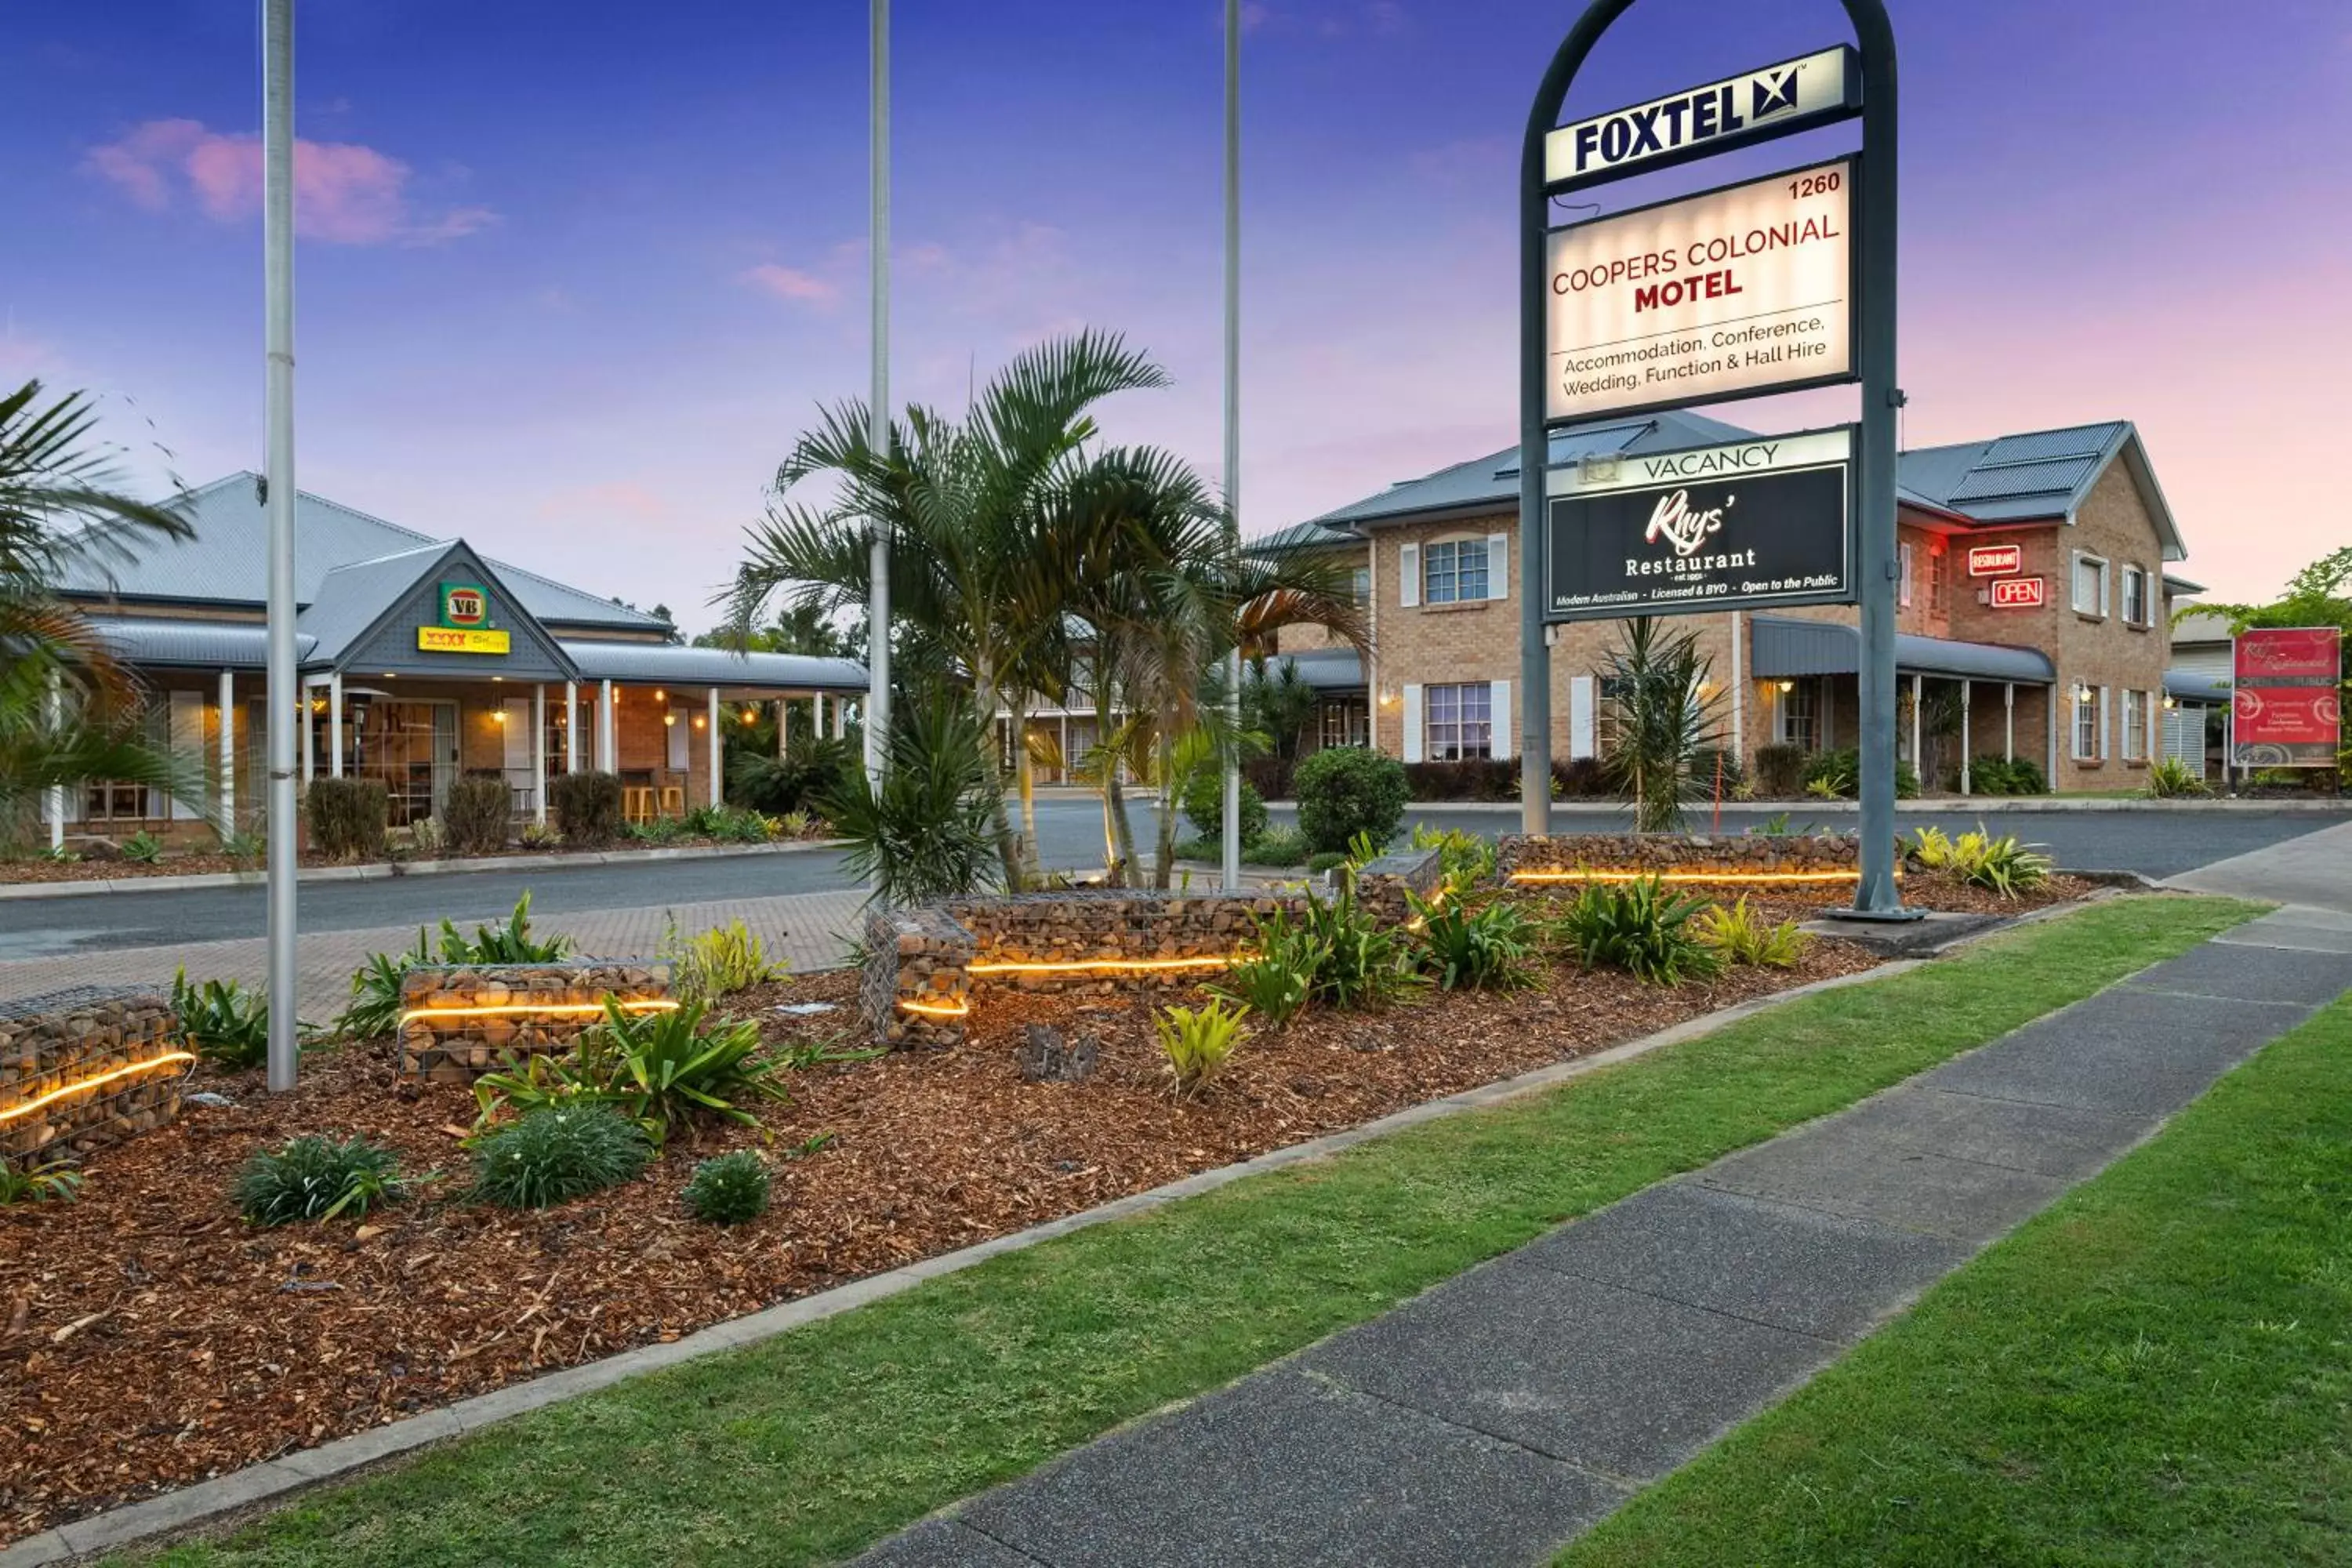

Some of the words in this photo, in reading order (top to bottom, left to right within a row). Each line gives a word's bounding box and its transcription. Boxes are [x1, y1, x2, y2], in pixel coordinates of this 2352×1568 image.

[1576, 85, 1744, 171] FOXTEL
[1788, 172, 1840, 200] 1260
[1552, 249, 1677, 296] COOPERS
[1687, 214, 1840, 266] COLONIAL
[1635, 269, 1743, 313] MOTEL
[1564, 338, 1708, 374] Accommodation,
[1711, 316, 1825, 349] Conference,
[1563, 376, 1641, 397] Wedding,
[1646, 358, 1722, 383] Function
[1727, 354, 1740, 370] &
[1745, 347, 1782, 367] Hall
[1787, 340, 1827, 360] Hire
[1645, 444, 1779, 478] VACANCY
[1625, 548, 1756, 577] Restaurant
[453, 599, 477, 613] VB
[1556, 594, 1591, 606] Modern
[1651, 585, 1694, 600] Licensed
[1696, 585, 1704, 596] &
[1705, 583, 1727, 595] BYO
[1741, 580, 1768, 593] Open
[1771, 579, 1781, 590] to
[1784, 576, 1802, 588] the
[1803, 573, 1838, 586] Public
[1997, 582, 2038, 602] OPEN
